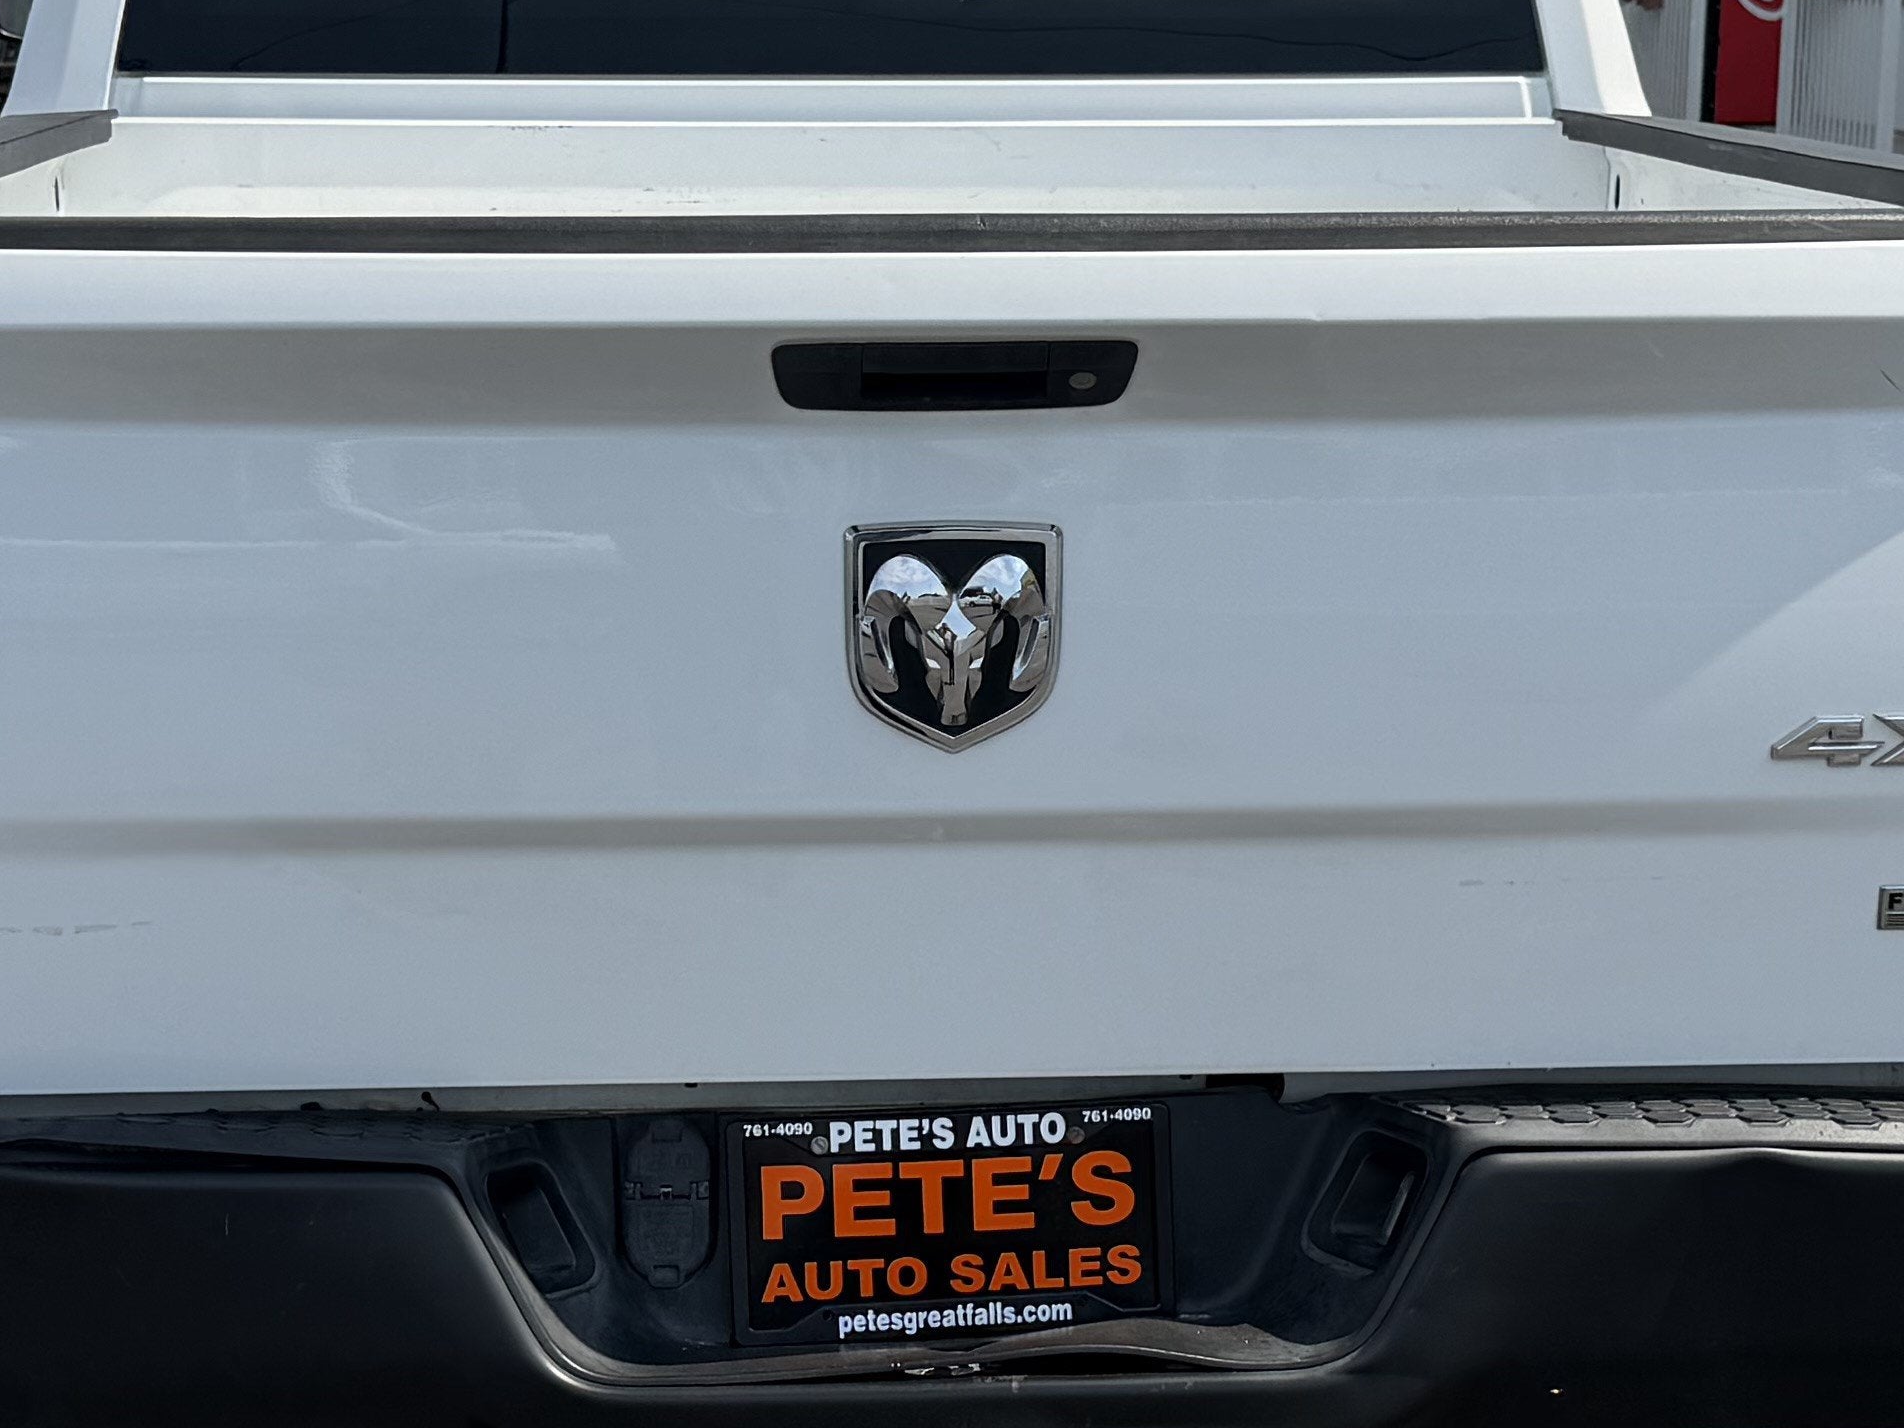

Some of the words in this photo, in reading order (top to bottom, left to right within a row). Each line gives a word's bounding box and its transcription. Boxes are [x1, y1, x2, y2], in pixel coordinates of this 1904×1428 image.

[830, 1117, 954, 1153] PETE'S
[966, 1112, 1066, 1148] AUTO
[760, 1150, 1136, 1240] PETE'S
[761, 1257, 927, 1303] AUTO
[950, 1244, 1142, 1293] SALES
[838, 1300, 1073, 1339] petesgreatfalls.com
